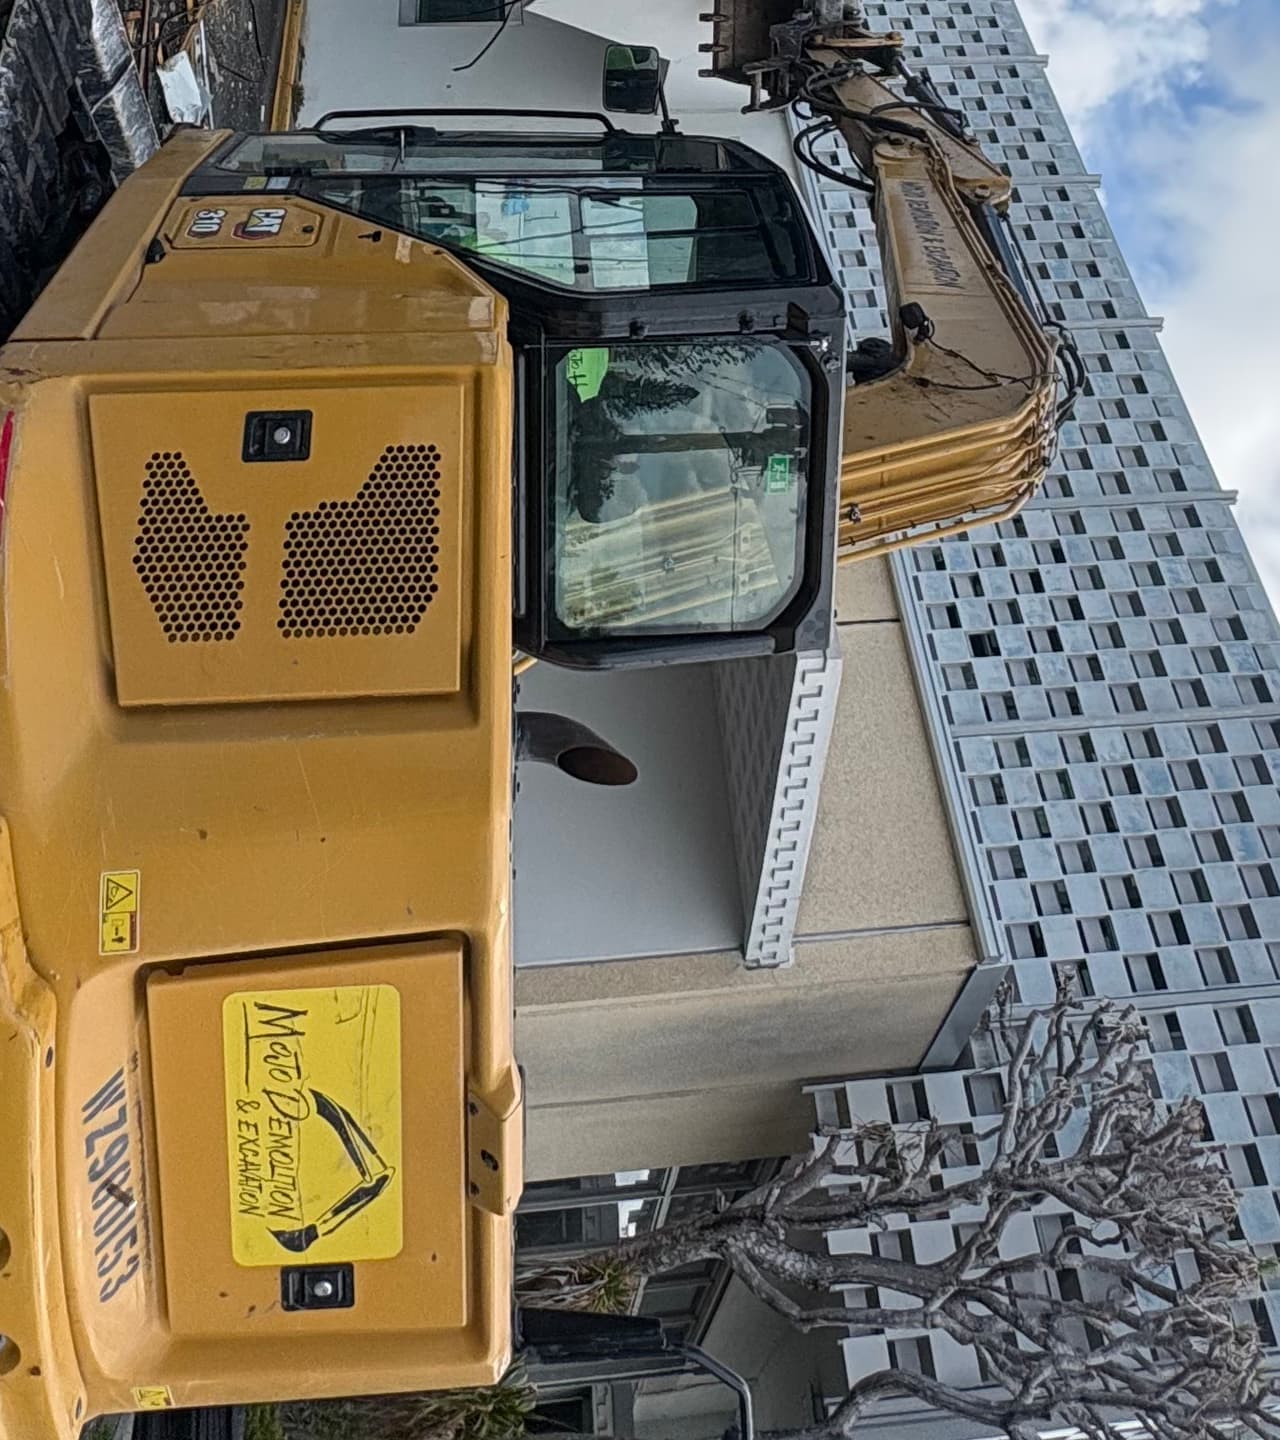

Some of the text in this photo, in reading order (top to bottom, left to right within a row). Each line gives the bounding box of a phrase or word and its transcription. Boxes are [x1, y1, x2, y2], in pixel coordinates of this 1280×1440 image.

[190, 209, 227, 233] 310
[244, 208, 288, 233] CAT
[235, 1098, 267, 1218] & EXCAVATION
